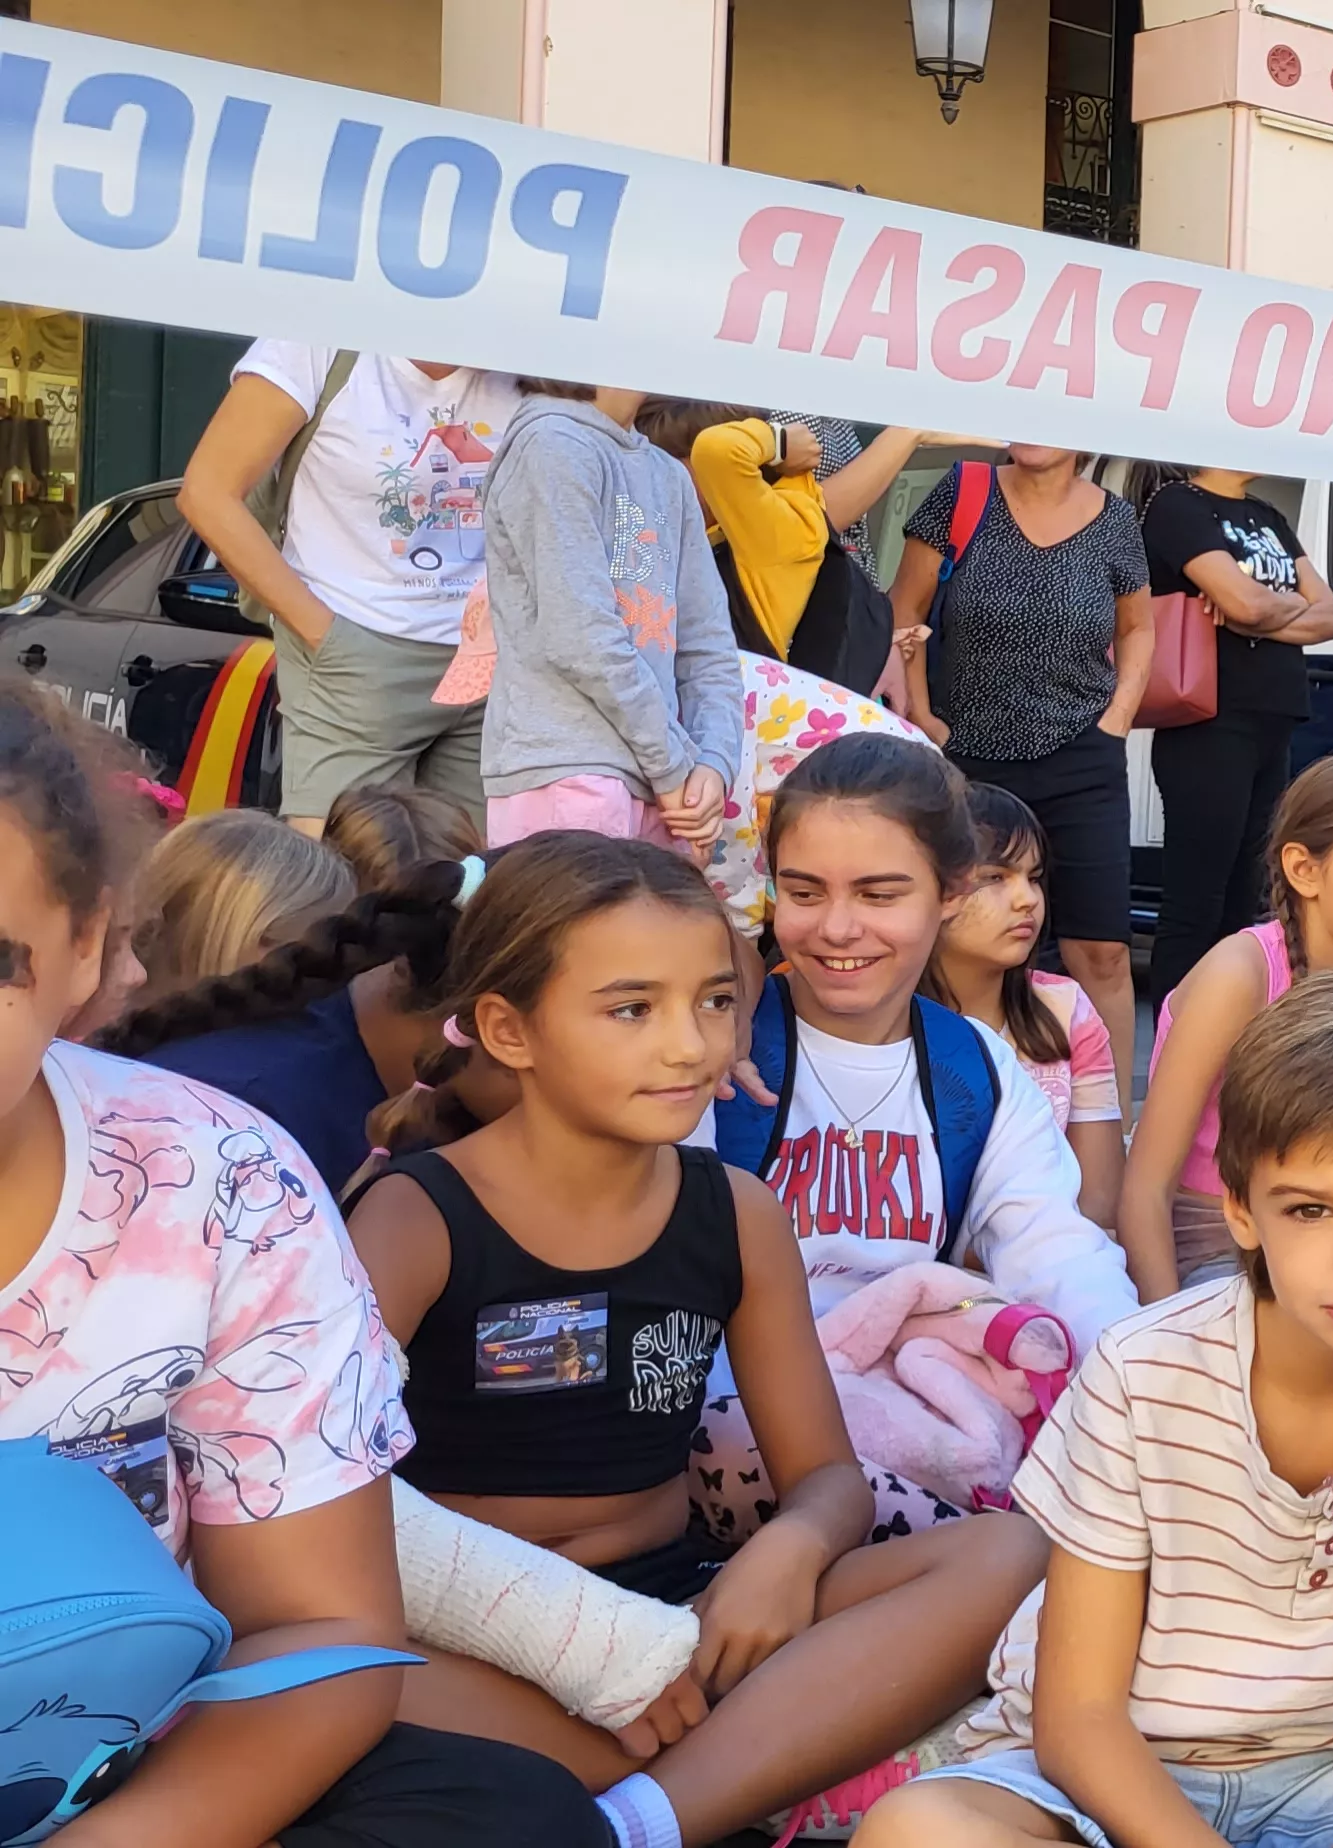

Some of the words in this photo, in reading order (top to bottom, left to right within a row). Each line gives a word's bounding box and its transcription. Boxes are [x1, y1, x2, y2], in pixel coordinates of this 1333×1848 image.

[1253, 553, 1296, 584] LOVE
[765, 1122, 948, 1250] ROOKL
[519, 1306, 582, 1319] NACIONAL
[520, 1300, 569, 1313] POLICIA
[495, 1343, 555, 1361] POLICÍA
[51, 1436, 110, 1456] OLICIA
